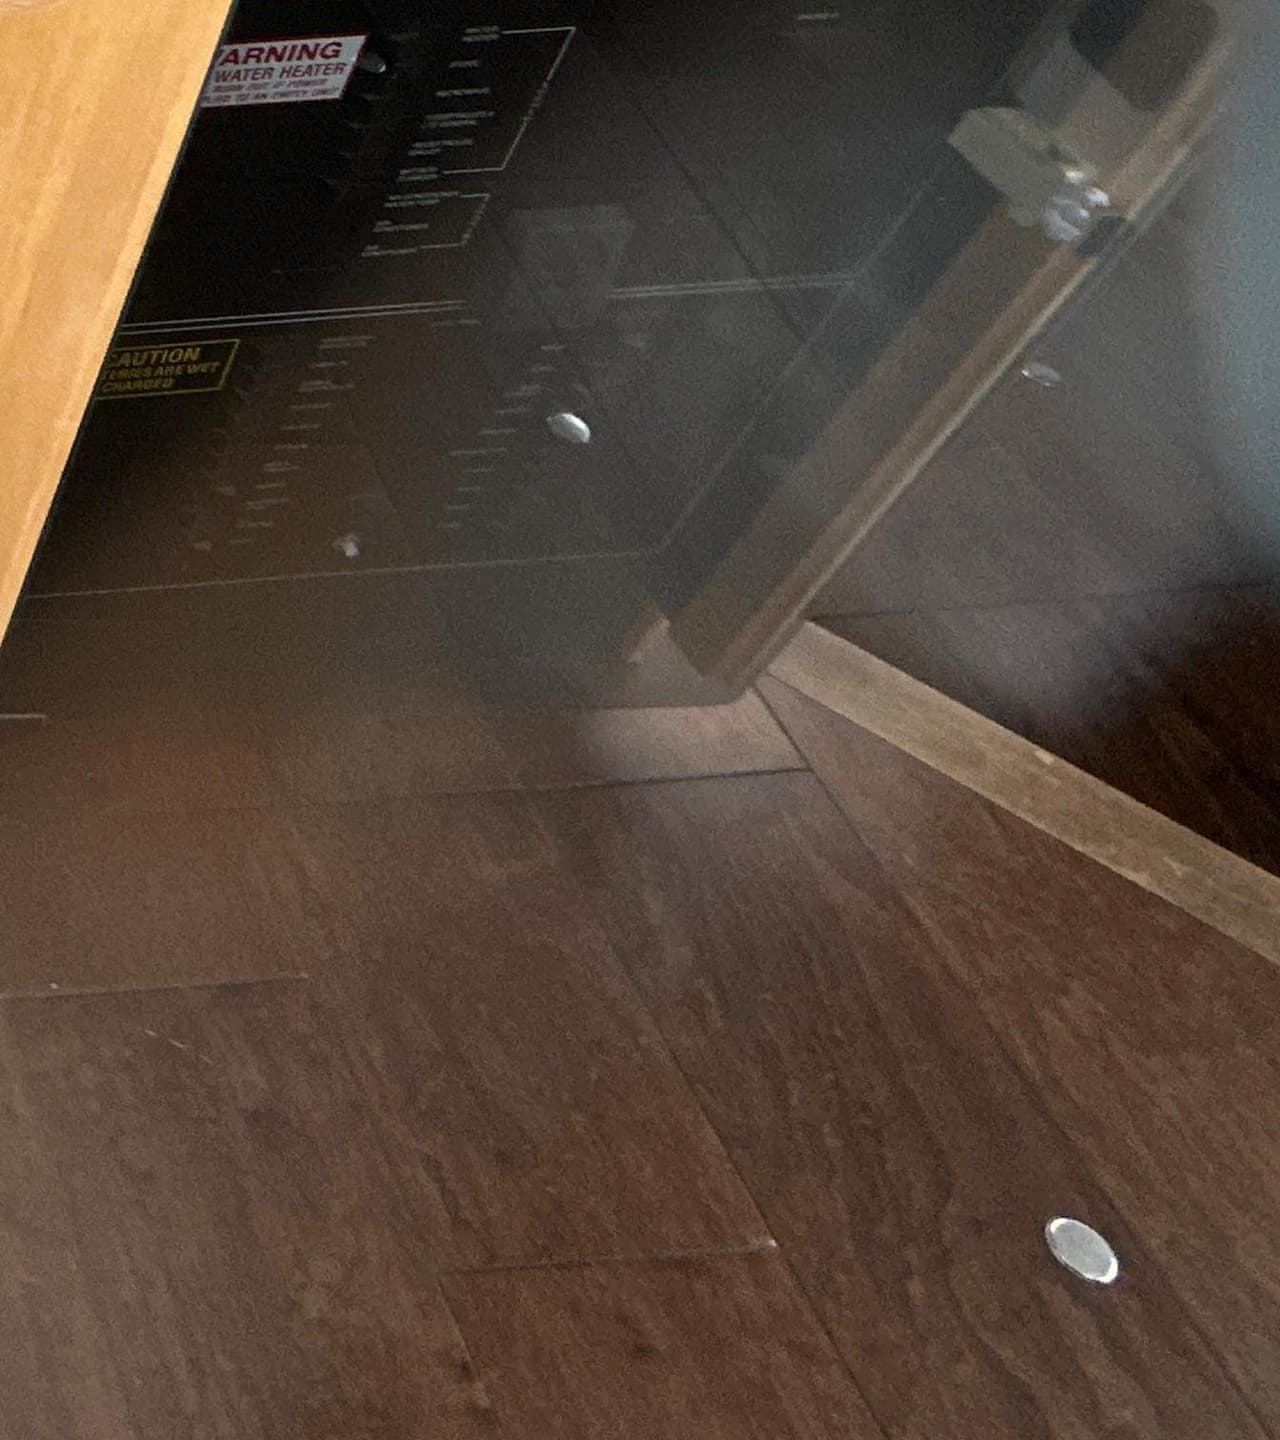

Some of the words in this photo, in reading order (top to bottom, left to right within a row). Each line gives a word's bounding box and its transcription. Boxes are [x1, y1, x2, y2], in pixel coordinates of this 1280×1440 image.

[219, 42, 342, 66] ARNING
[215, 67, 274, 82] WATER
[279, 62, 347, 79] HEATER
